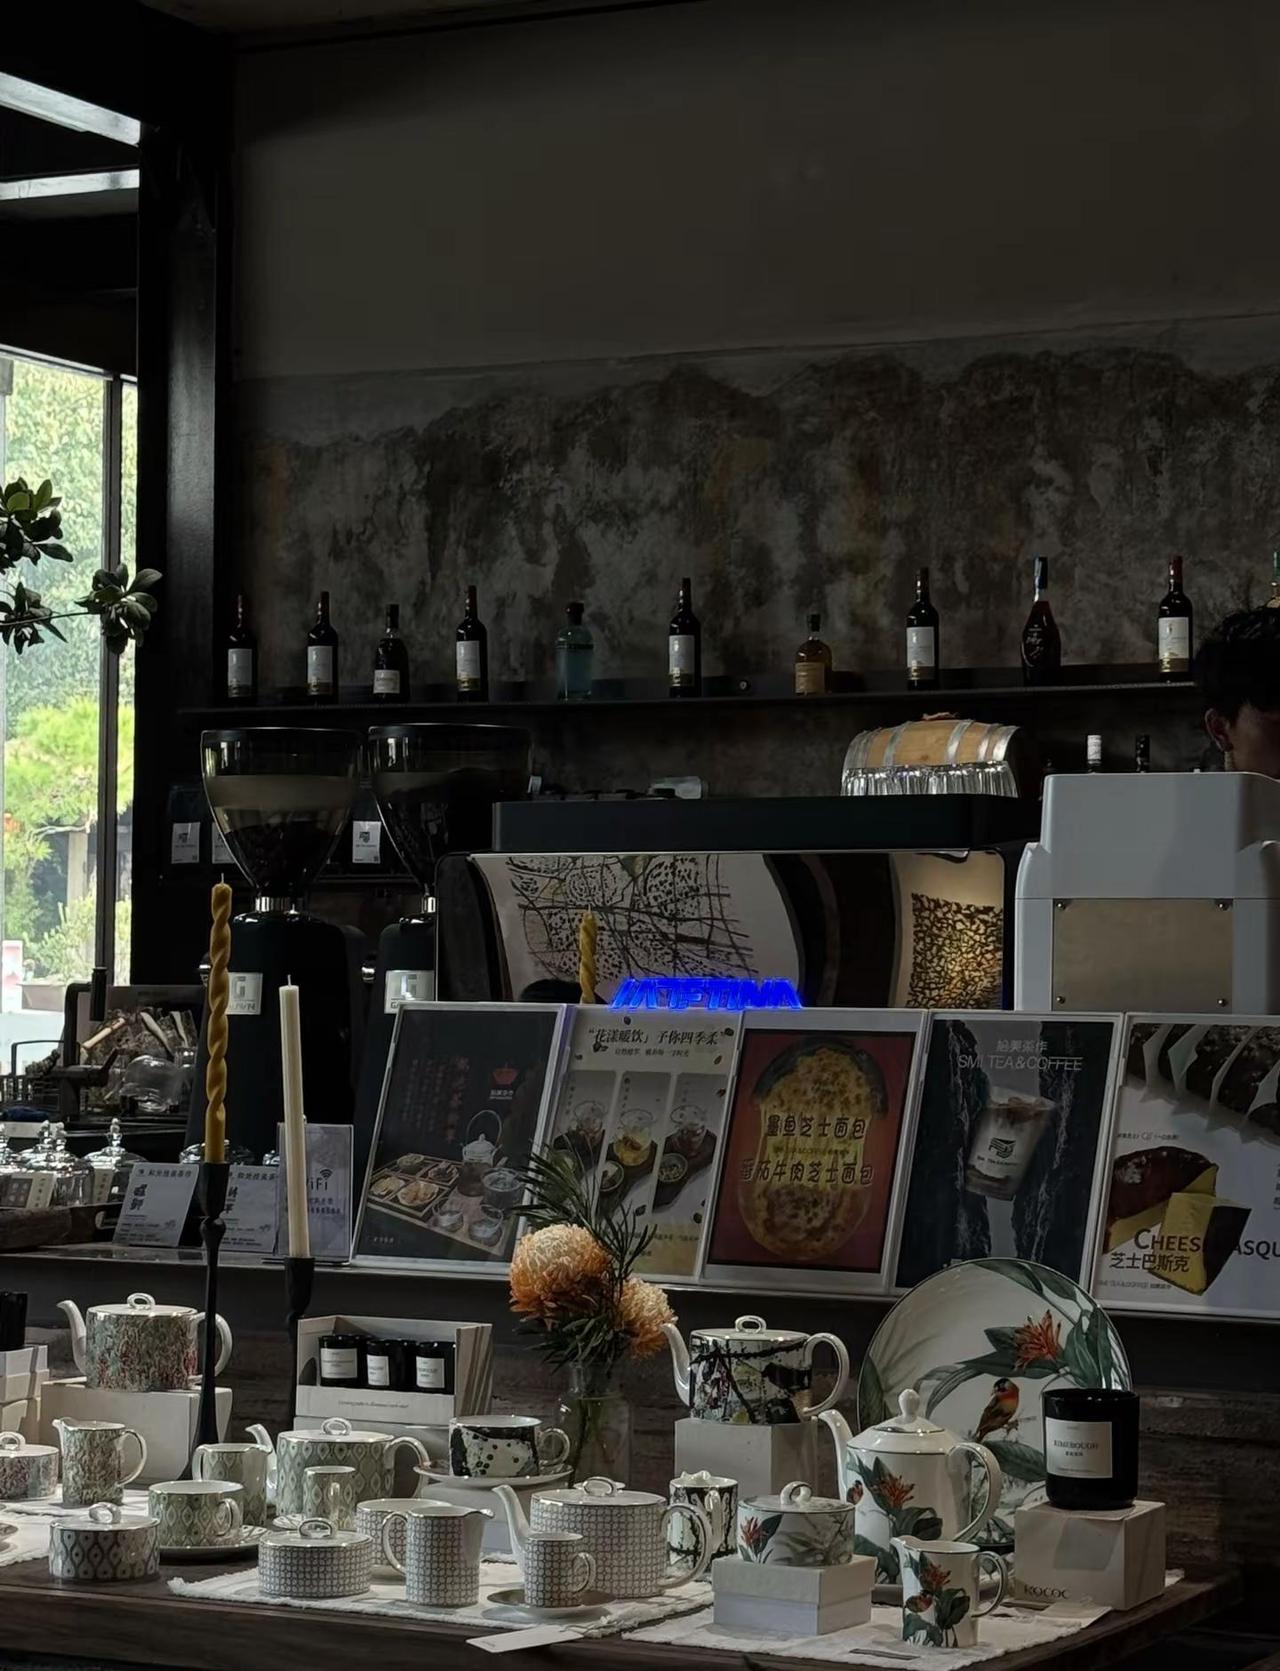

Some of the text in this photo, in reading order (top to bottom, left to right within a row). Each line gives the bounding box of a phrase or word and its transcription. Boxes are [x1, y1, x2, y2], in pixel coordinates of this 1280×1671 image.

[768, 1115, 865, 1140] 墨鱼芝士面包
[743, 1159, 874, 1184] 番茄牛肉芝士面包
[307, 1177, 329, 1191] iFi
[1109, 1252, 1190, 1273] 芝士巴斯克
